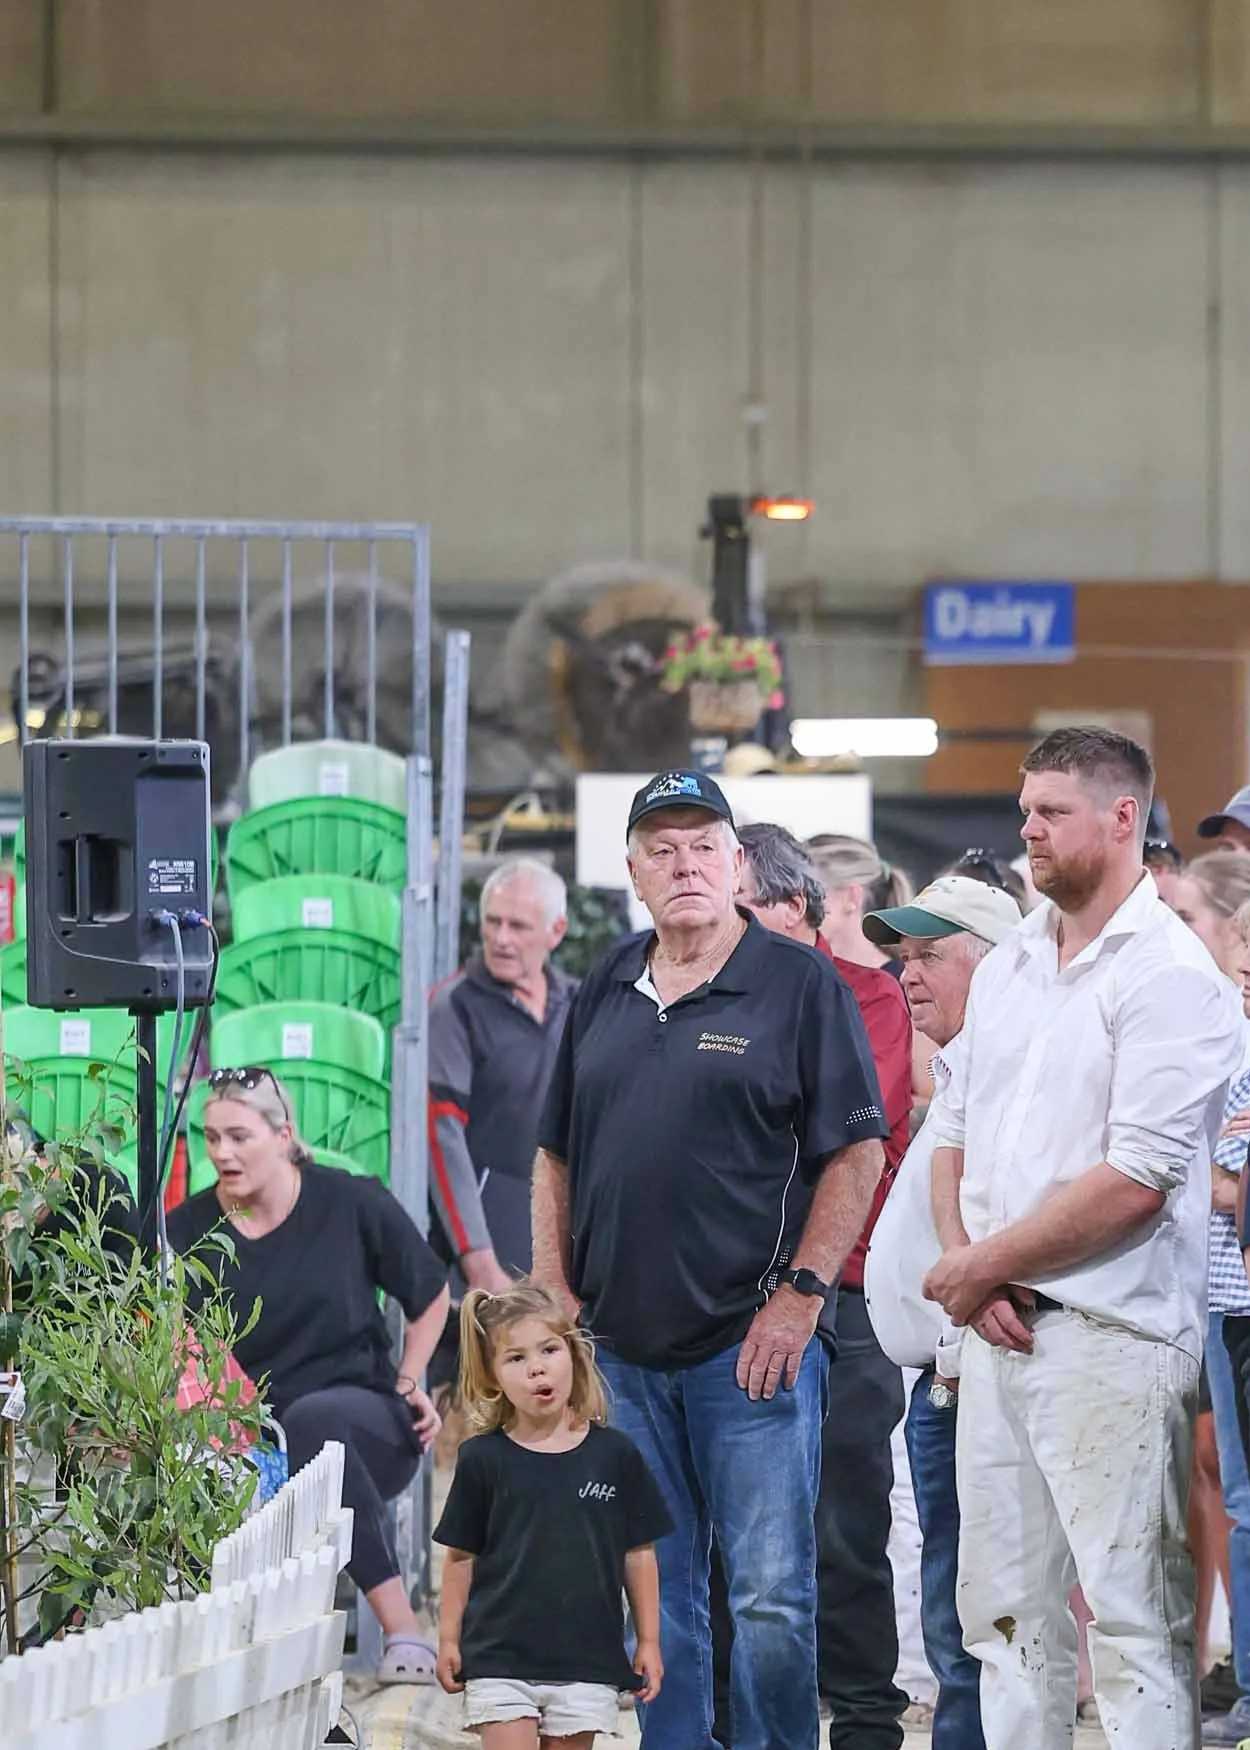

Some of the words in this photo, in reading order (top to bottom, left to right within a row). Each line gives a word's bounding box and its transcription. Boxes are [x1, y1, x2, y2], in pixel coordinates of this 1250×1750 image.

[935, 589, 1056, 649] Dairy
[699, 1032, 752, 1047] SHOWCASE
[697, 1042, 745, 1055] BOARDING
